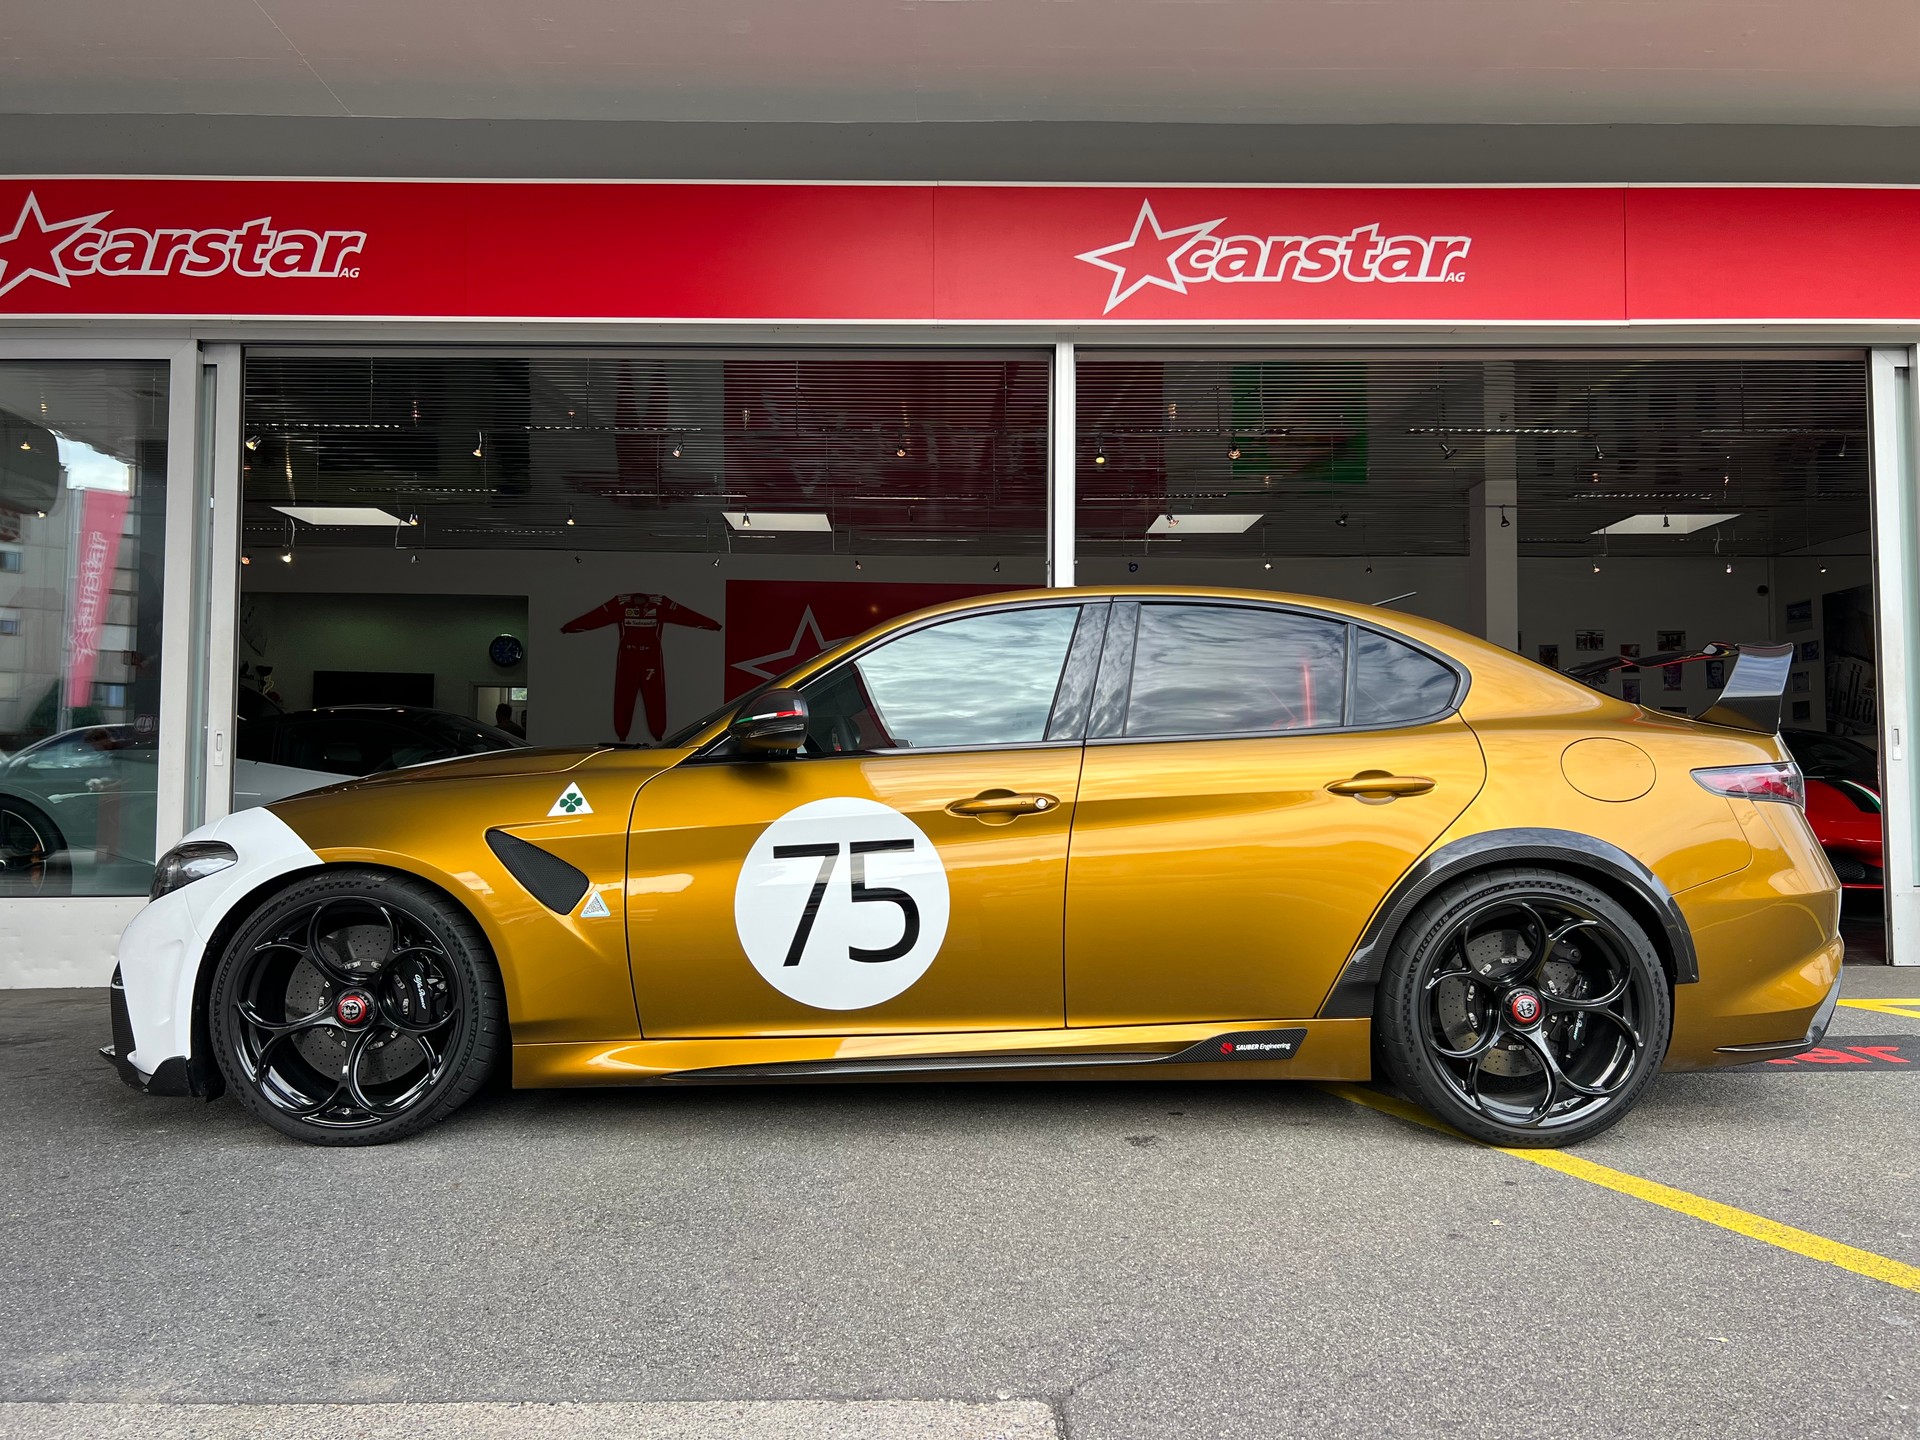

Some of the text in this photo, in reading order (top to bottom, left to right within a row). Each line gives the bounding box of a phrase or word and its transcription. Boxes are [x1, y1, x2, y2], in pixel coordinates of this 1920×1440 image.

[56, 216, 367, 279] carstar AG
[1173, 222, 1472, 283] carstar AG
[645, 668, 656, 681] 7
[773, 838, 920, 968] 75
[1414, 913, 1449, 960] MICHELIN
[1450, 900, 1464, 914] PILOT
[1482, 886, 1496, 896] CUP
[215, 949, 236, 1002] MICHELIN
[456, 1021, 477, 1073] MICHELIN
[1236, 1043, 1291, 1051] SAUBER Engineering
